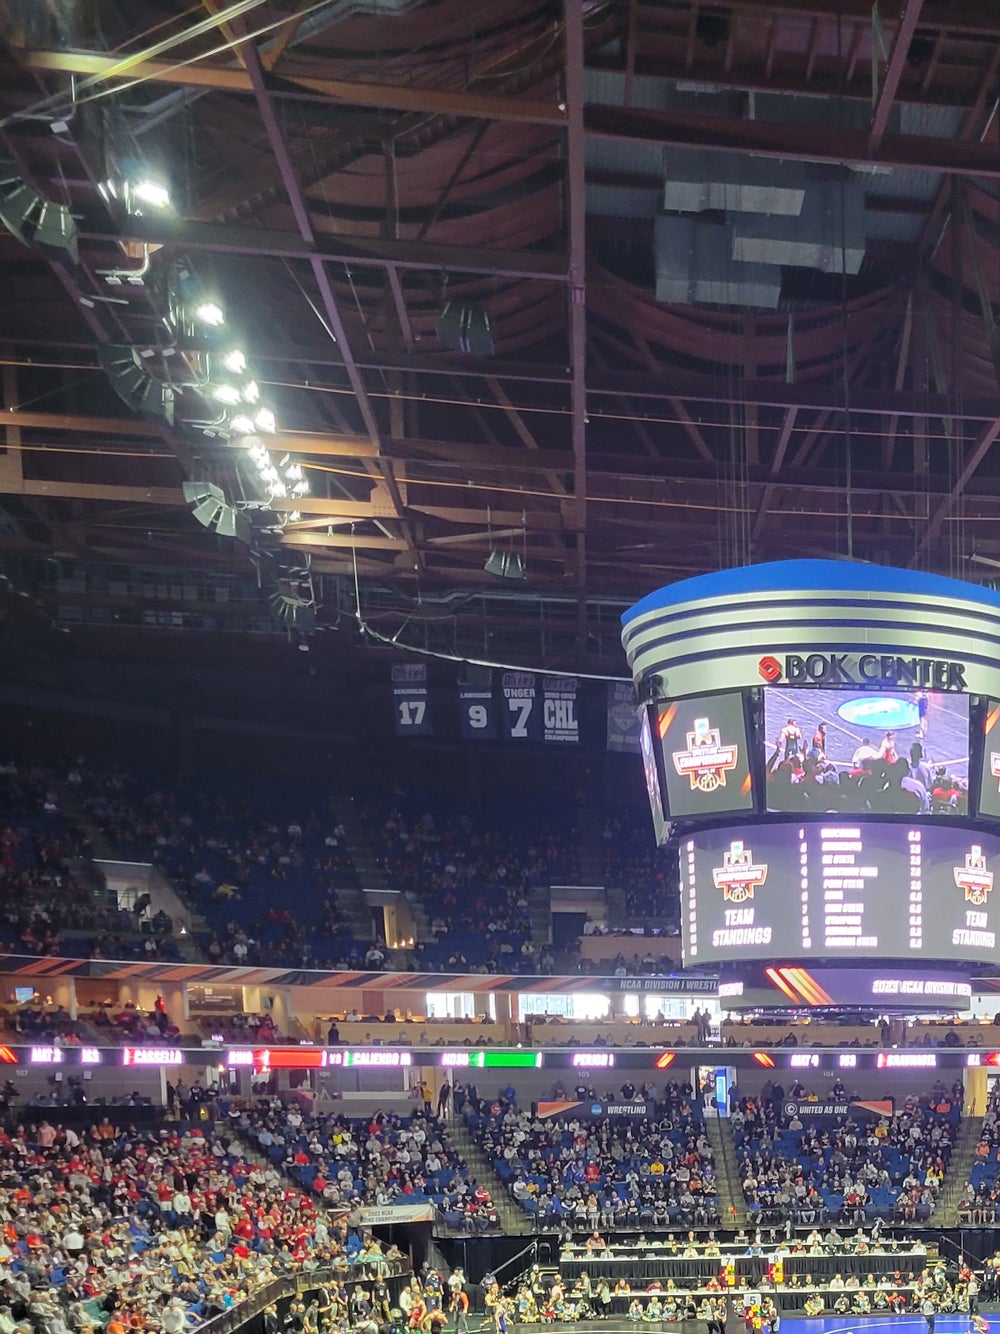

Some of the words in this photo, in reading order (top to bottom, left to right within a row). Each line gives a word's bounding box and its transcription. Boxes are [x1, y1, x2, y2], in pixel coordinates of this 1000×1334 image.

[785, 654, 853, 683] BOK
[859, 655, 968, 691] CENTER
[503, 688, 535, 698] UNGER
[399, 701, 426, 724] 17
[468, 705, 487, 728] 9
[508, 698, 533, 737] 7
[543, 699, 579, 729] CHL
[724, 908, 755, 926] TEAM
[965, 910, 988, 928] TEAM
[712, 927, 772, 946] STANDINGS
[952, 929, 995, 948] STANDINGS
[620, 980, 641, 988] NCAA
[644, 980, 680, 989] DIVISION
[686, 980, 719, 989] WRESTL
[330, 1053, 341, 1064] VS
[573, 1054, 607, 1066] PERIOD
[799, 1105, 823, 1114] UNITED
[824, 1105, 833, 1114] AS
[834, 1105, 848, 1114] ONE
[773, 1254, 779, 1262] 8
[749, 1296, 756, 1305] 5
